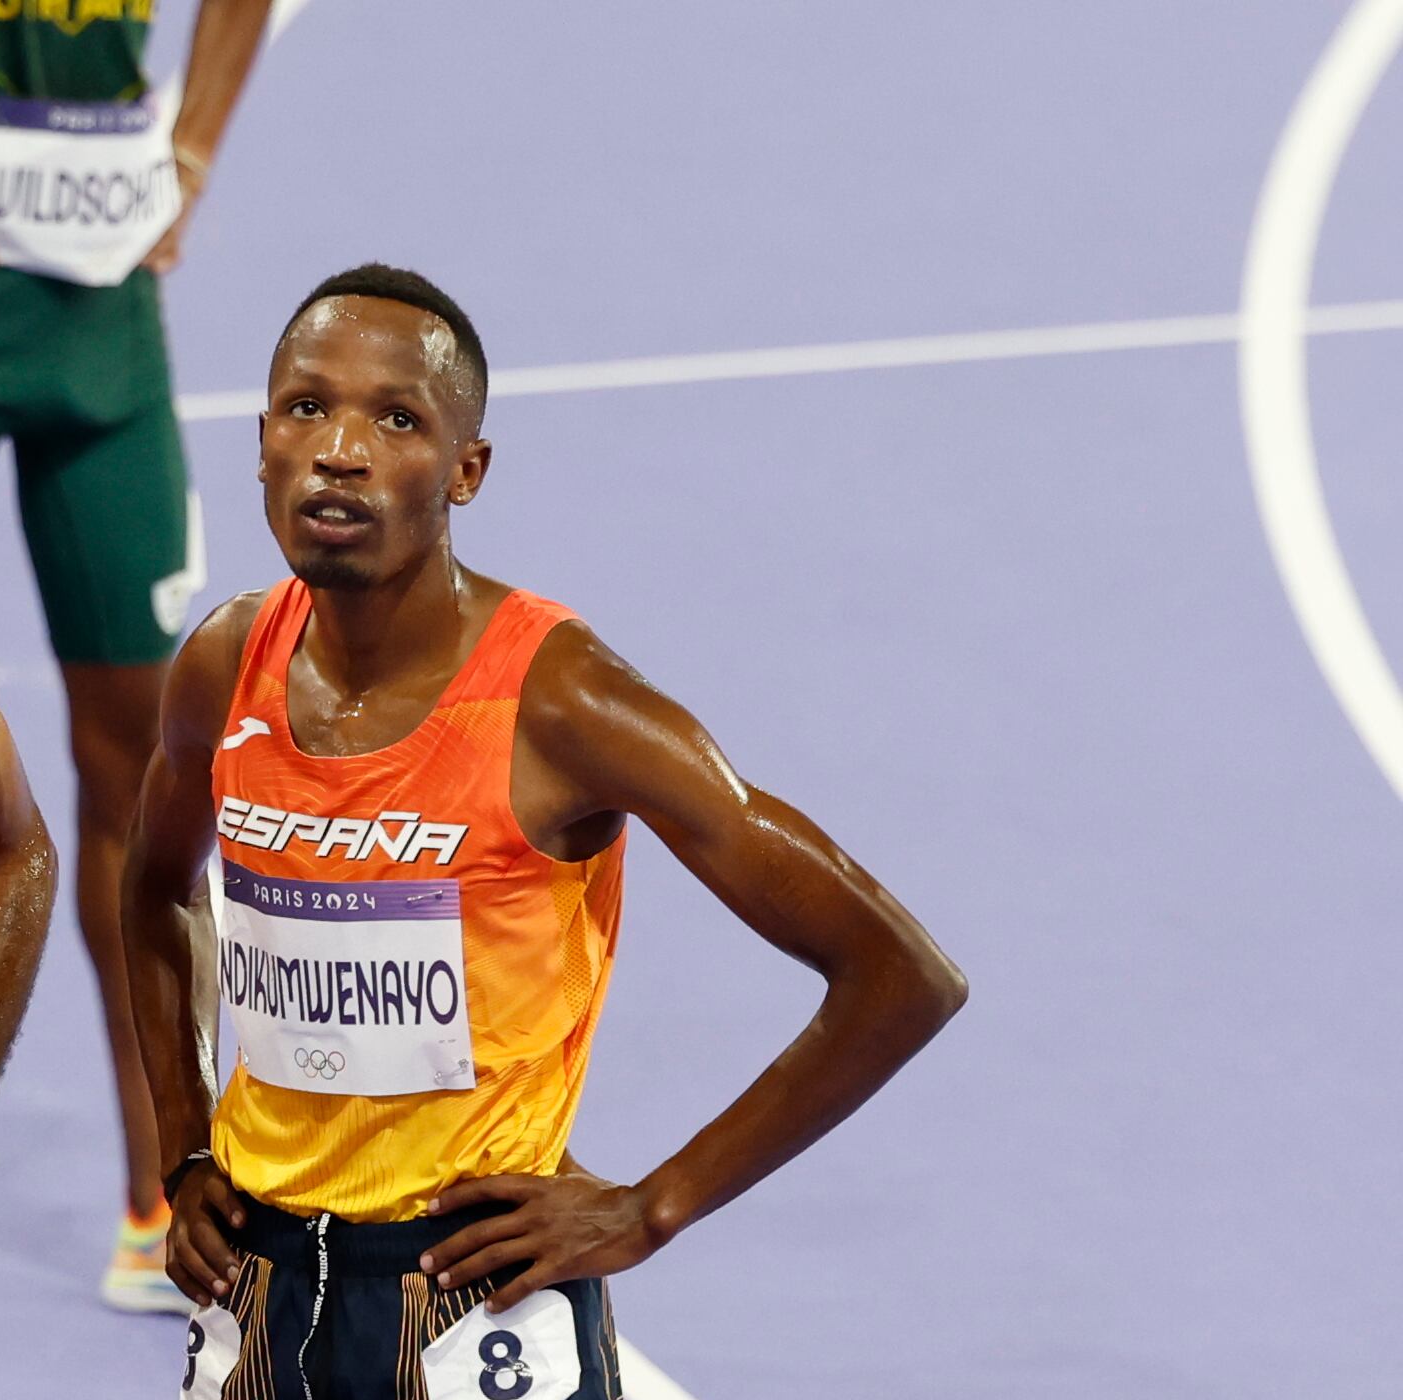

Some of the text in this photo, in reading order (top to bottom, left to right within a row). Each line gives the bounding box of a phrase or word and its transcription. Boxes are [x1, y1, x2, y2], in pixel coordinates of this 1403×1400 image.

[217, 795, 469, 866] ESPAÑA
[253, 882, 376, 911] PARIS 2024
[219, 937, 459, 1026] NDIKUMWENAYO
